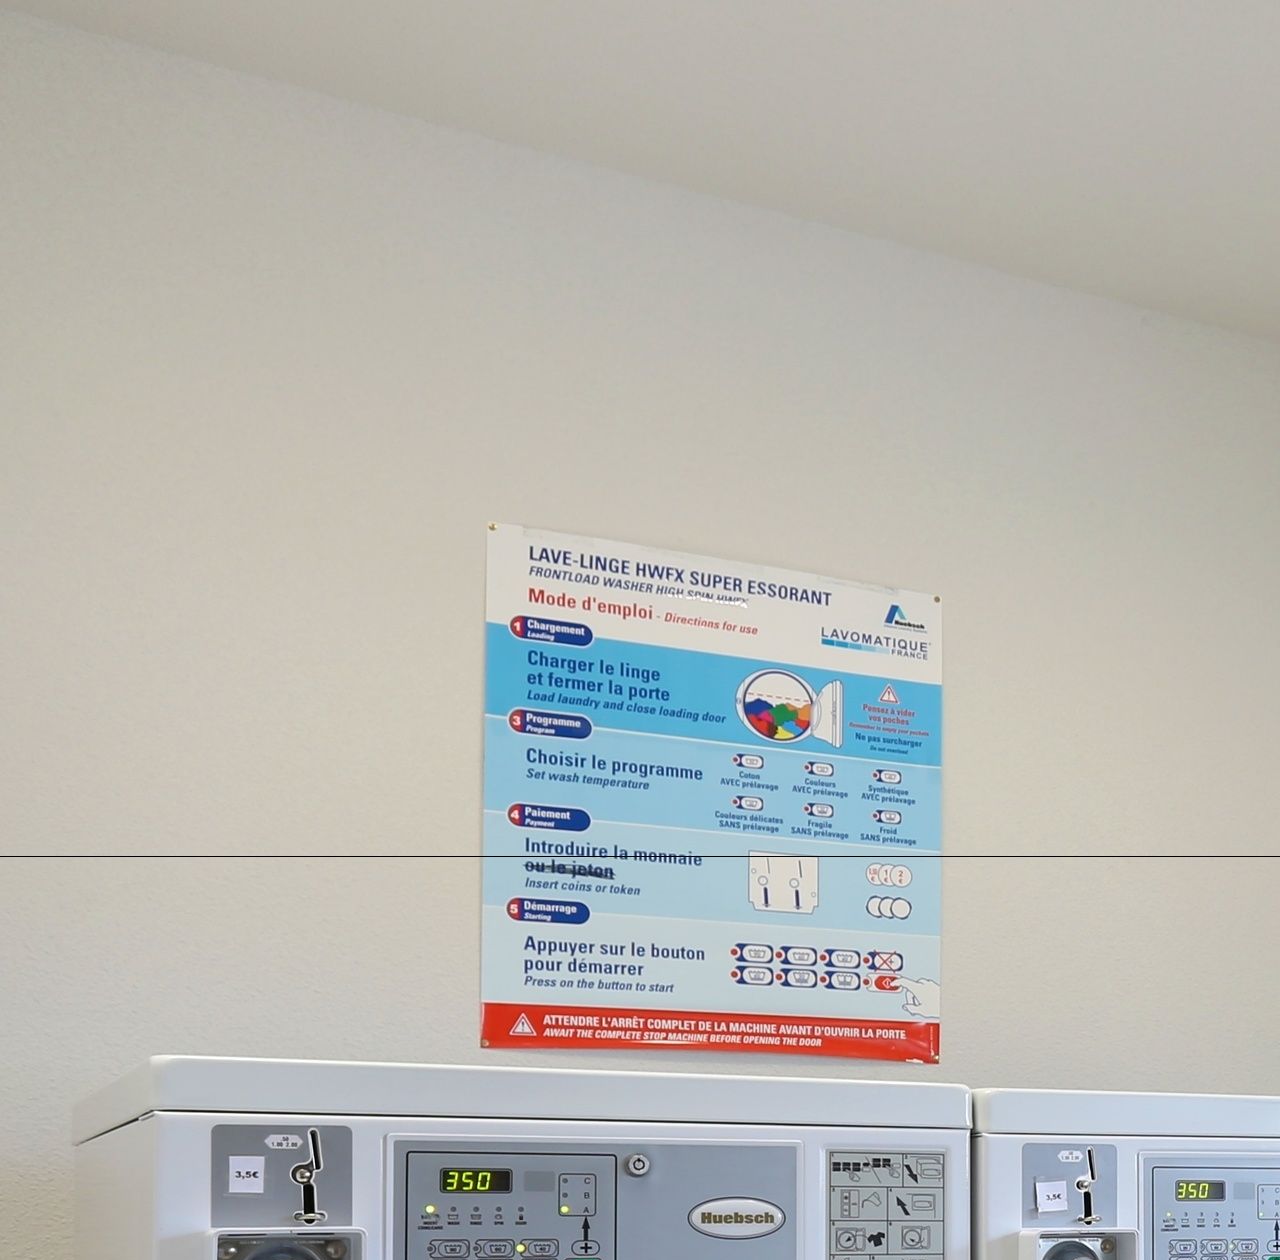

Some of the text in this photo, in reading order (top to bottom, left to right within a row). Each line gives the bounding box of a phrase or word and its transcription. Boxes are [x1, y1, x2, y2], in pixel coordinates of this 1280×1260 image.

[529, 546, 832, 606] LAVE-LINGE HWFX SUPER ESSORANT
[529, 566, 600, 585] FRONTLOAD
[603, 578, 653, 594] WASHER
[529, 588, 576, 608] Mode
[582, 597, 653, 620] d'emploi
[664, 612, 720, 630] Directions
[722, 621, 737, 632] for
[739, 625, 758, 635] use
[514, 619, 585, 636] 1 Chargement
[891, 648, 928, 661] FRANCE
[527, 650, 661, 683] Charger le linge
[527, 672, 670, 701] et fermer la porte
[527, 690, 726, 724] Load laundry and close loading door
[512, 713, 581, 729] 3 Programme
[526, 748, 703, 781] Choisir le programme
[526, 768, 649, 790] Set wash temperature
[720, 777, 740, 787] AVEC
[739, 770, 760, 780] Coton
[510, 806, 571, 820] 4 Paiement
[791, 826, 812, 836] SANS
[807, 819, 832, 829] Fragile
[525, 837, 702, 866] Introduire la monnaie
[525, 877, 641, 896] Insert coins or token
[510, 900, 577, 915] 5 Démarrage
[524, 935, 705, 960] Appuyer sur le bouton
[524, 958, 644, 975] pour démarrer
[524, 976, 674, 993] Press on the button to start
[543, 1014, 906, 1040] ATTENDRE L'ARRÊT COMPLET DE LA MACHINE AVANT D'OUVRIR LA PORTE
[235, 1170, 259, 1180] 3,5€
[445, 1172, 491, 1191] 350
[584, 1177, 591, 1185] C
[584, 1191, 590, 1199] B
[1177, 1183, 1209, 1199] 350
[700, 1211, 776, 1226] Huebsch
